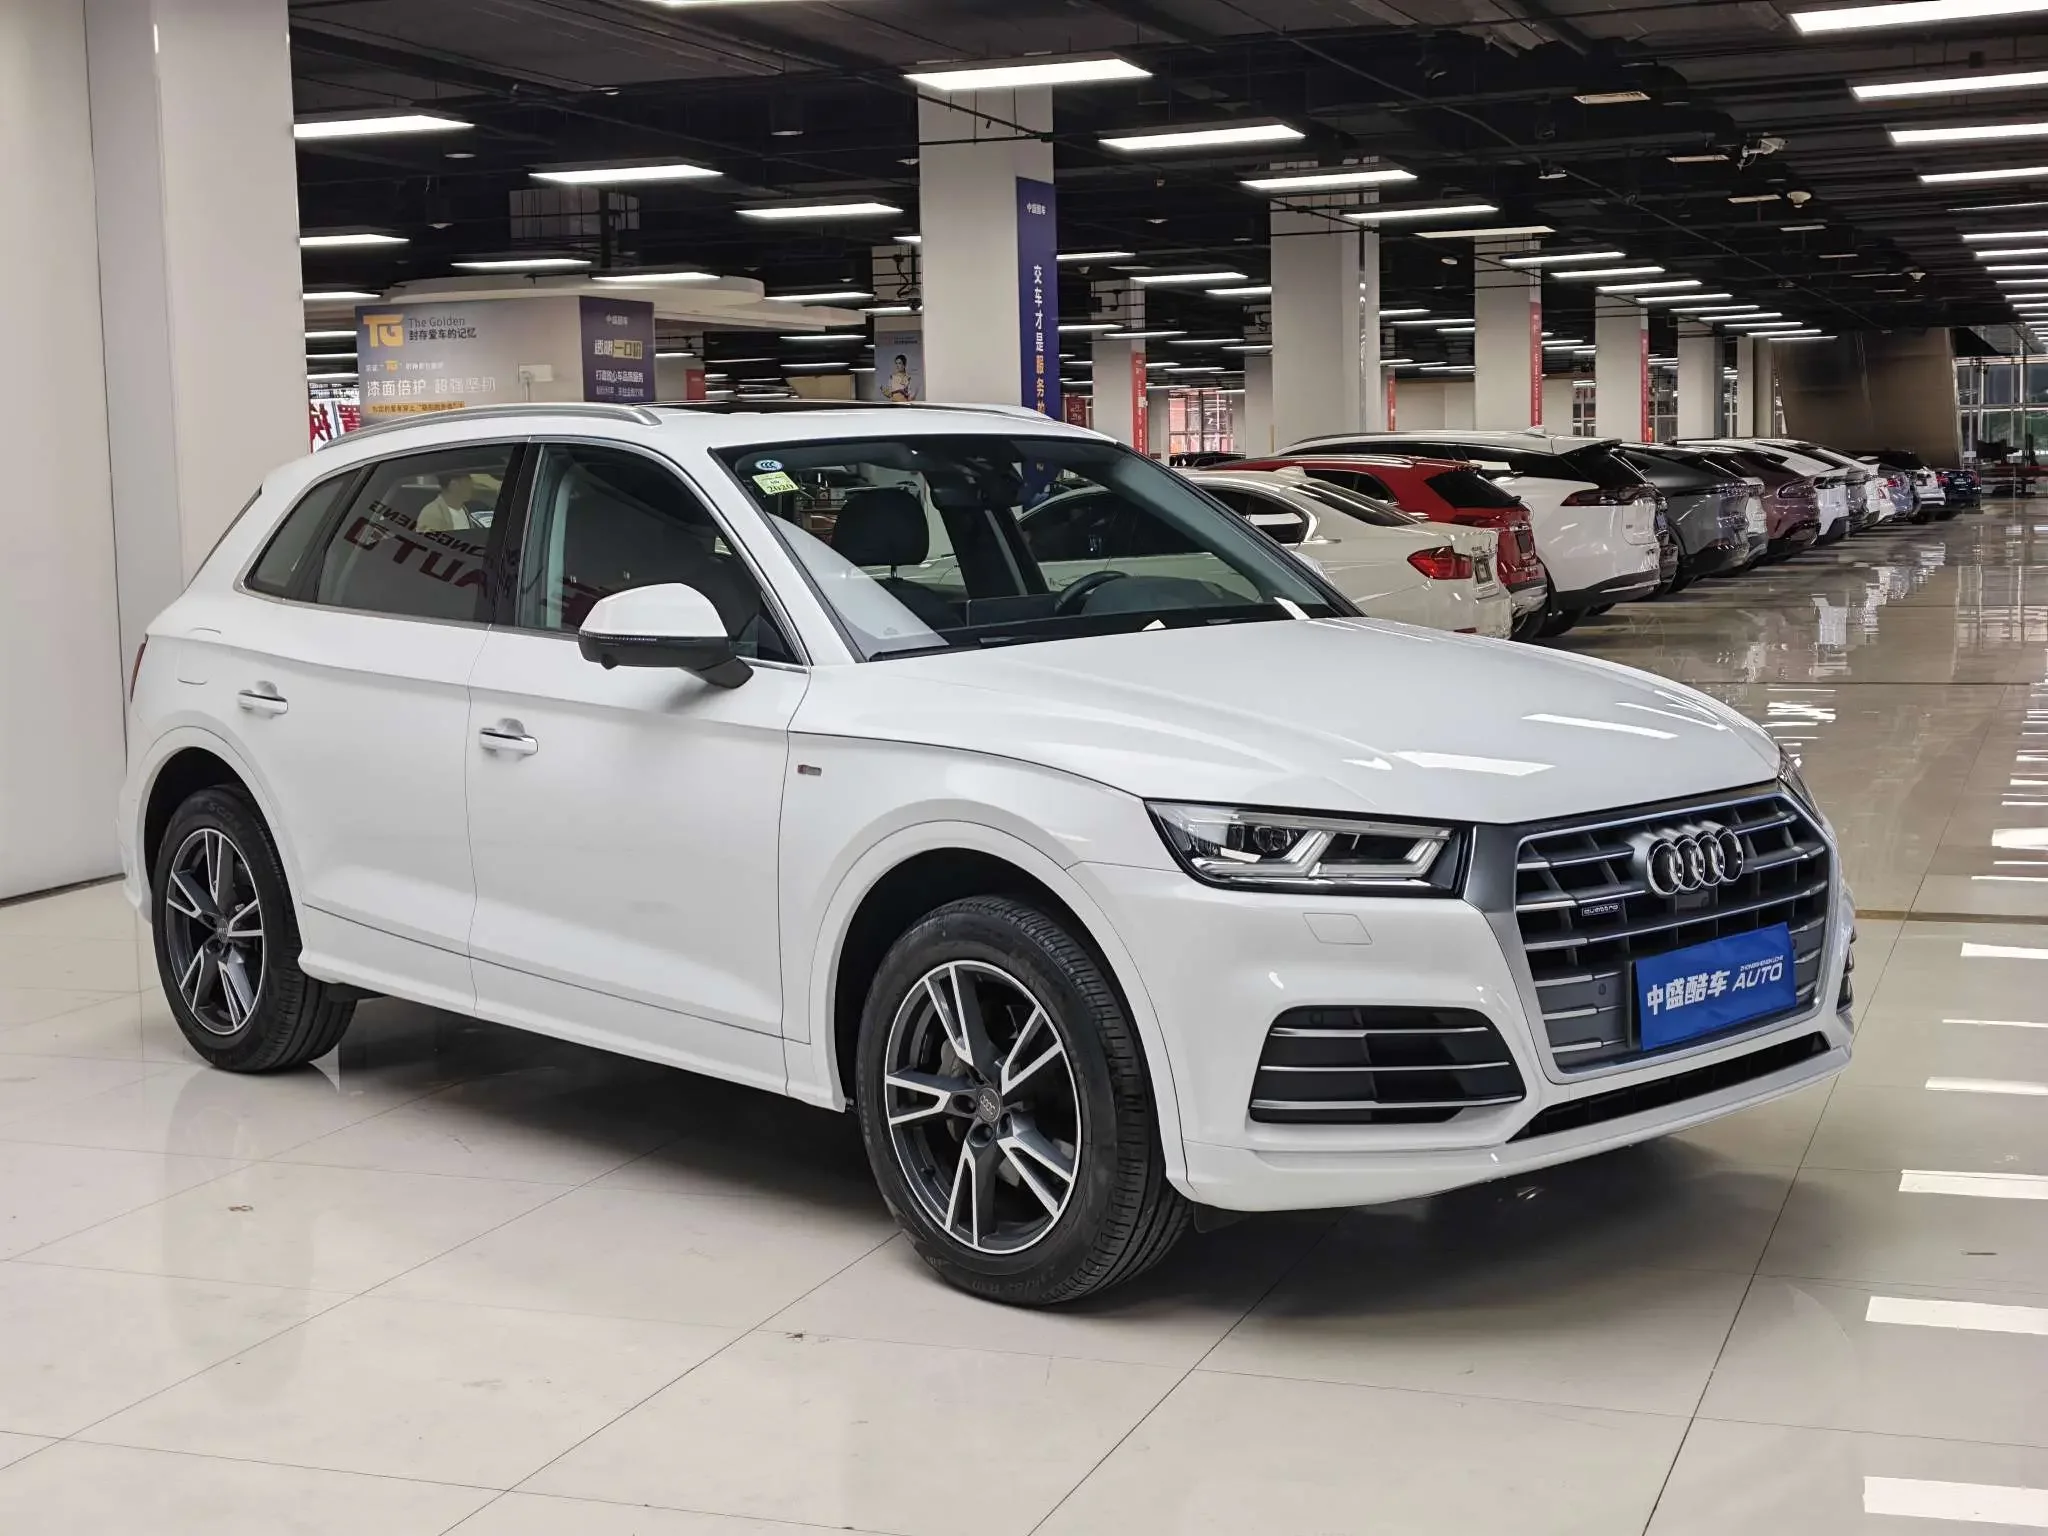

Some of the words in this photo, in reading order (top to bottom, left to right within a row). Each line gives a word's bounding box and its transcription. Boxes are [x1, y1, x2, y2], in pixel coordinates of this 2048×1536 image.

[409, 318, 427, 328] The
[429, 316, 465, 326] Golden
[409, 328, 477, 341] 封存爱车的记忆
[1732, 962, 1783, 992] AUTO
[1647, 970, 1730, 1016] 中盛酷车
